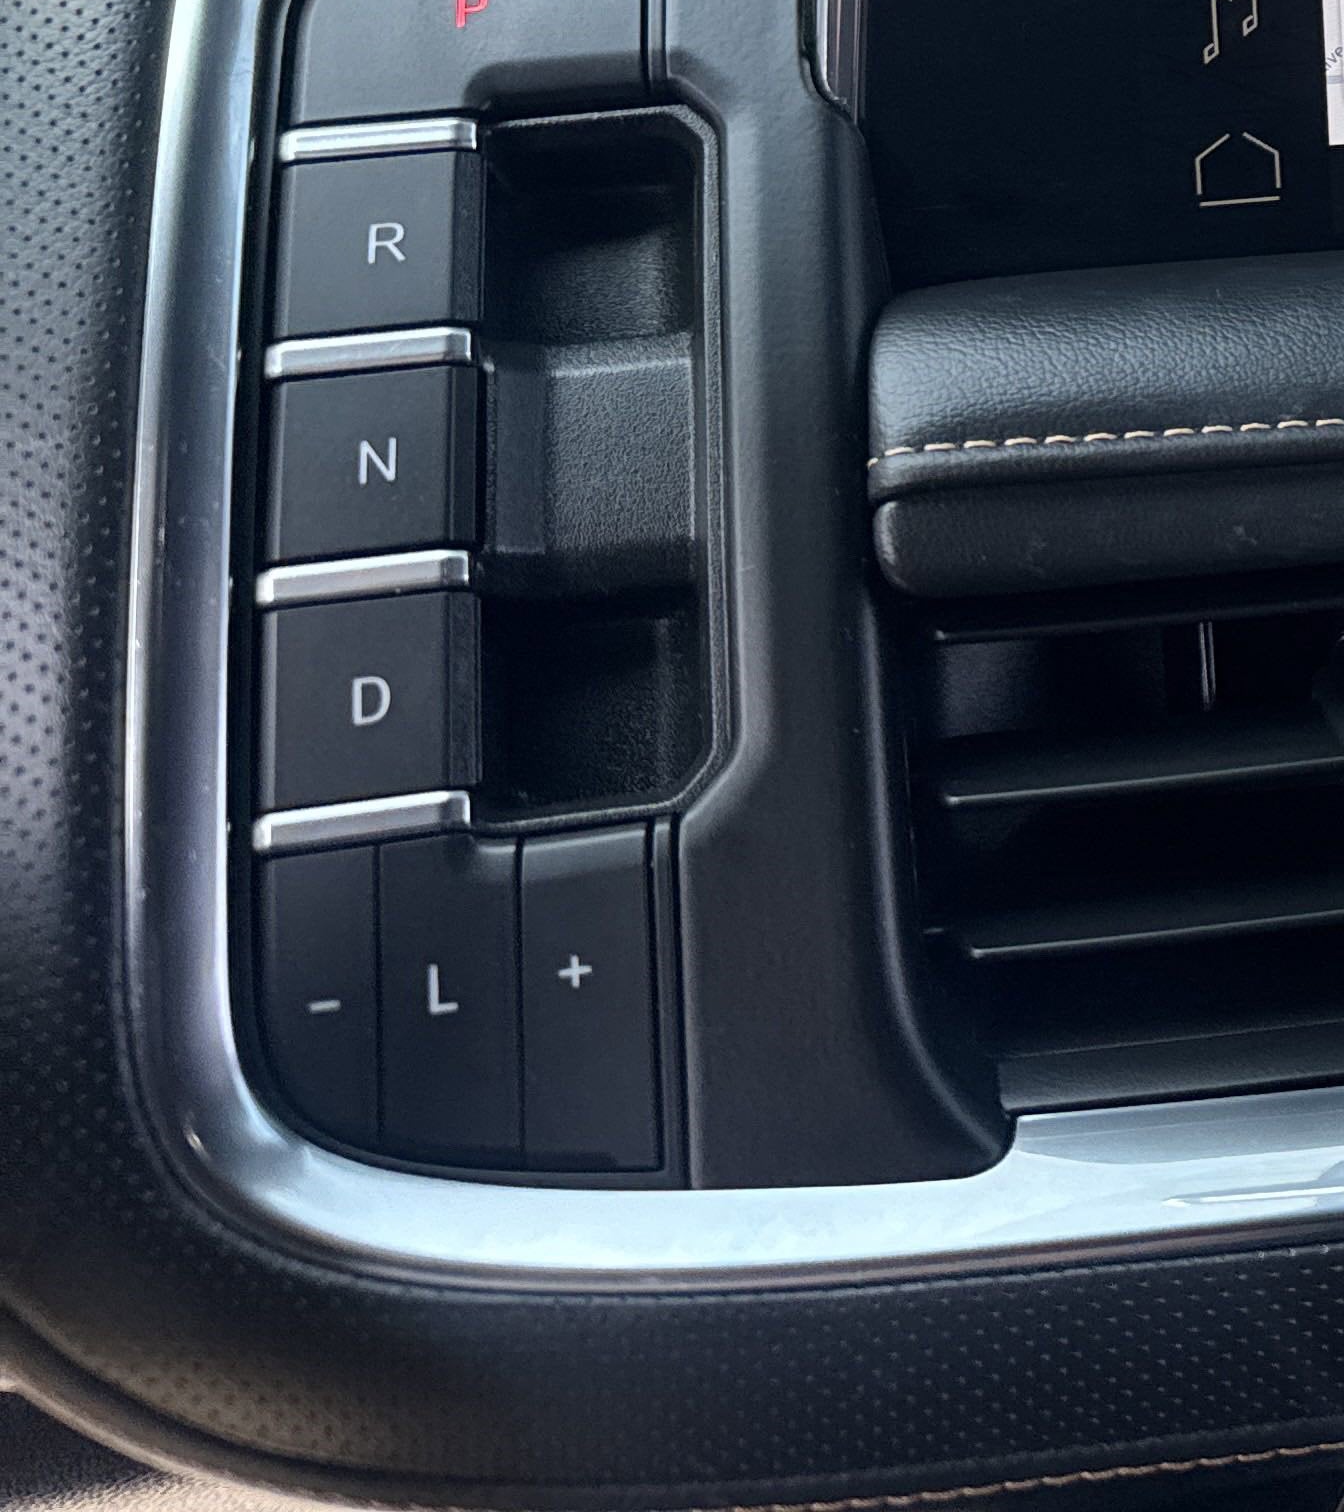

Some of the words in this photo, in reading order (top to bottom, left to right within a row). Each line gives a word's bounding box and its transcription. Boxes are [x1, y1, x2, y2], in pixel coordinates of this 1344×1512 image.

[367, 222, 407, 265] R
[358, 438, 397, 484] N
[351, 676, 391, 726] D
[428, 964, 458, 1015] L
